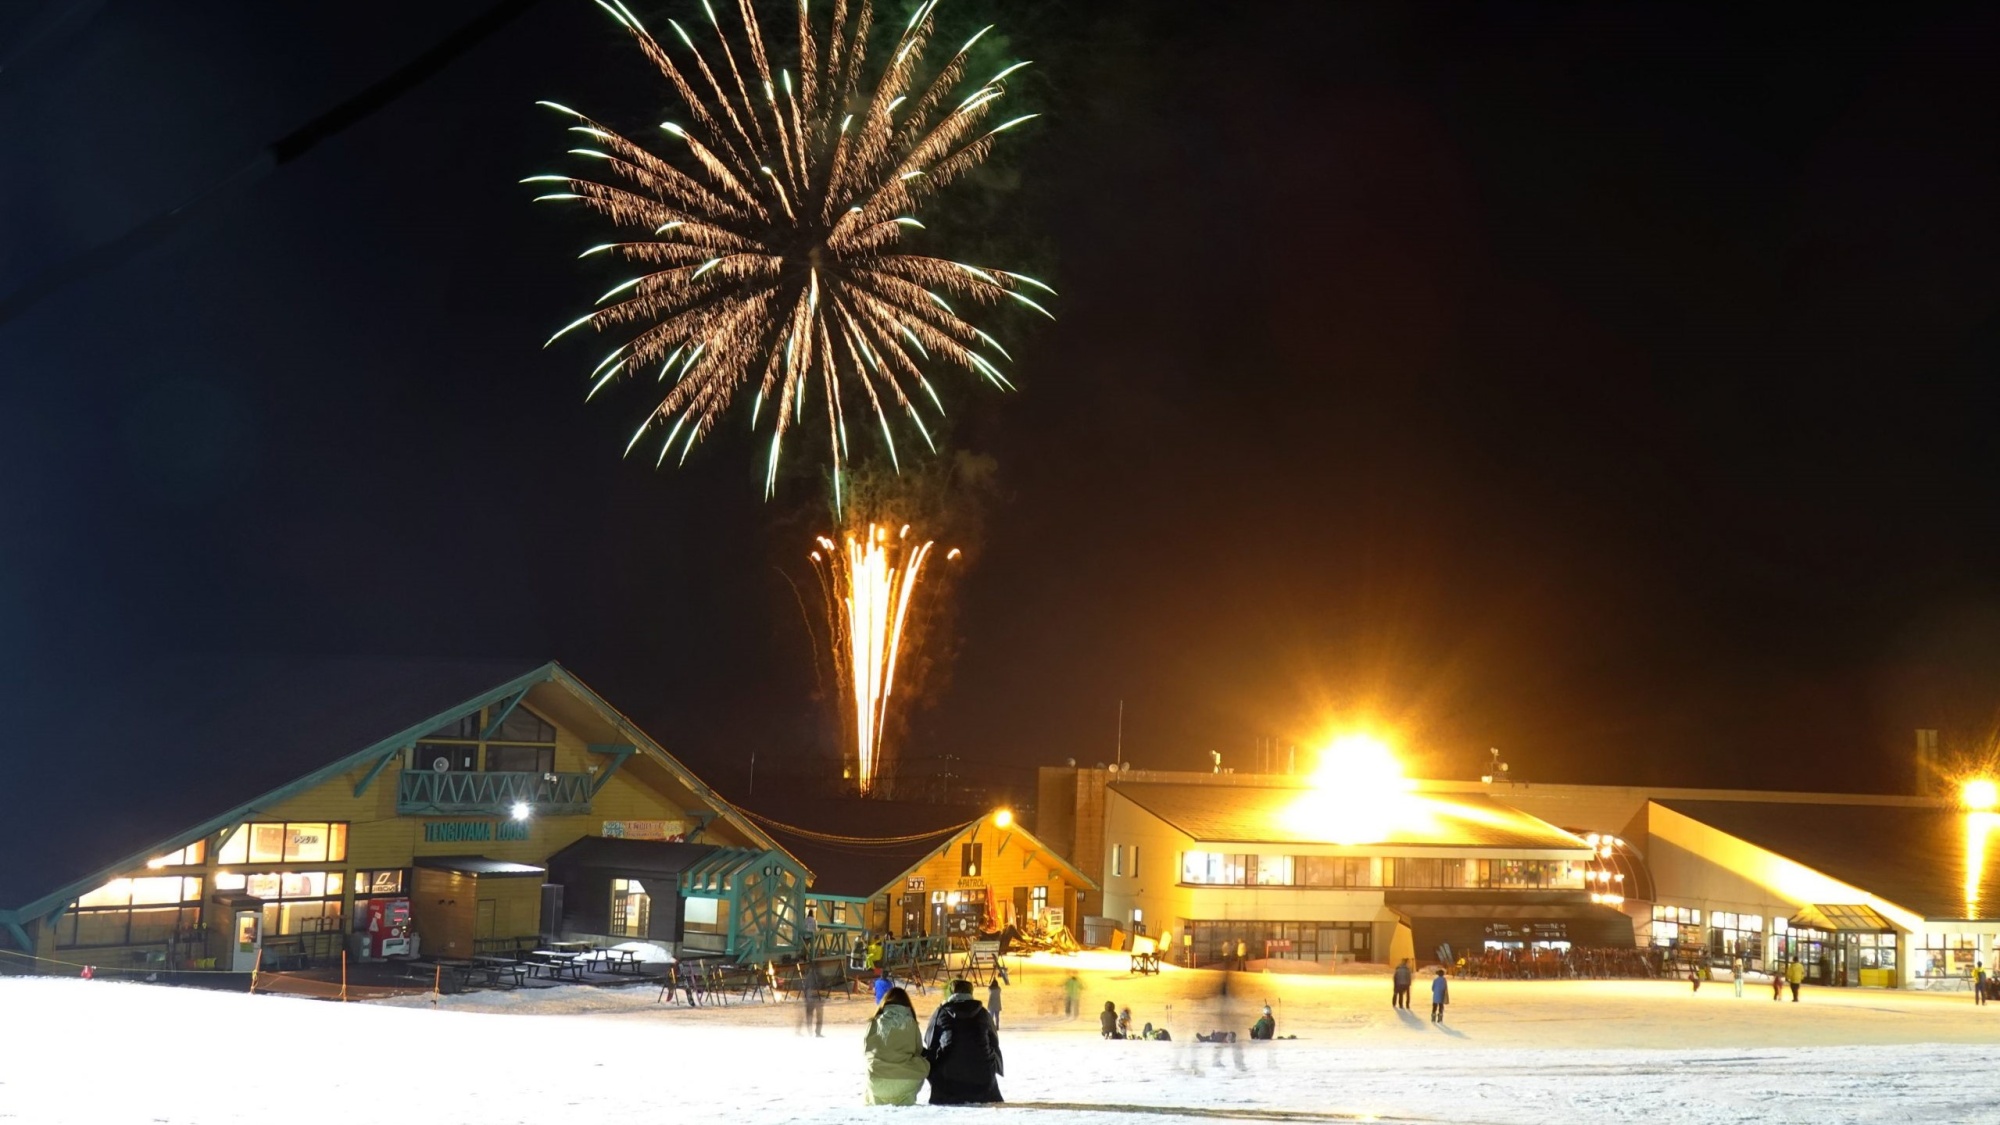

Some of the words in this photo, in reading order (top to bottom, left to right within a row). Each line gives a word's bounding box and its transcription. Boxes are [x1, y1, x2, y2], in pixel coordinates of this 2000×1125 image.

[425, 822, 491, 841] TENGUYAMA
[495, 822, 530, 841] LODGE
[294, 836, 318, 844] レンタル
[962, 878, 985, 888] PATROL
